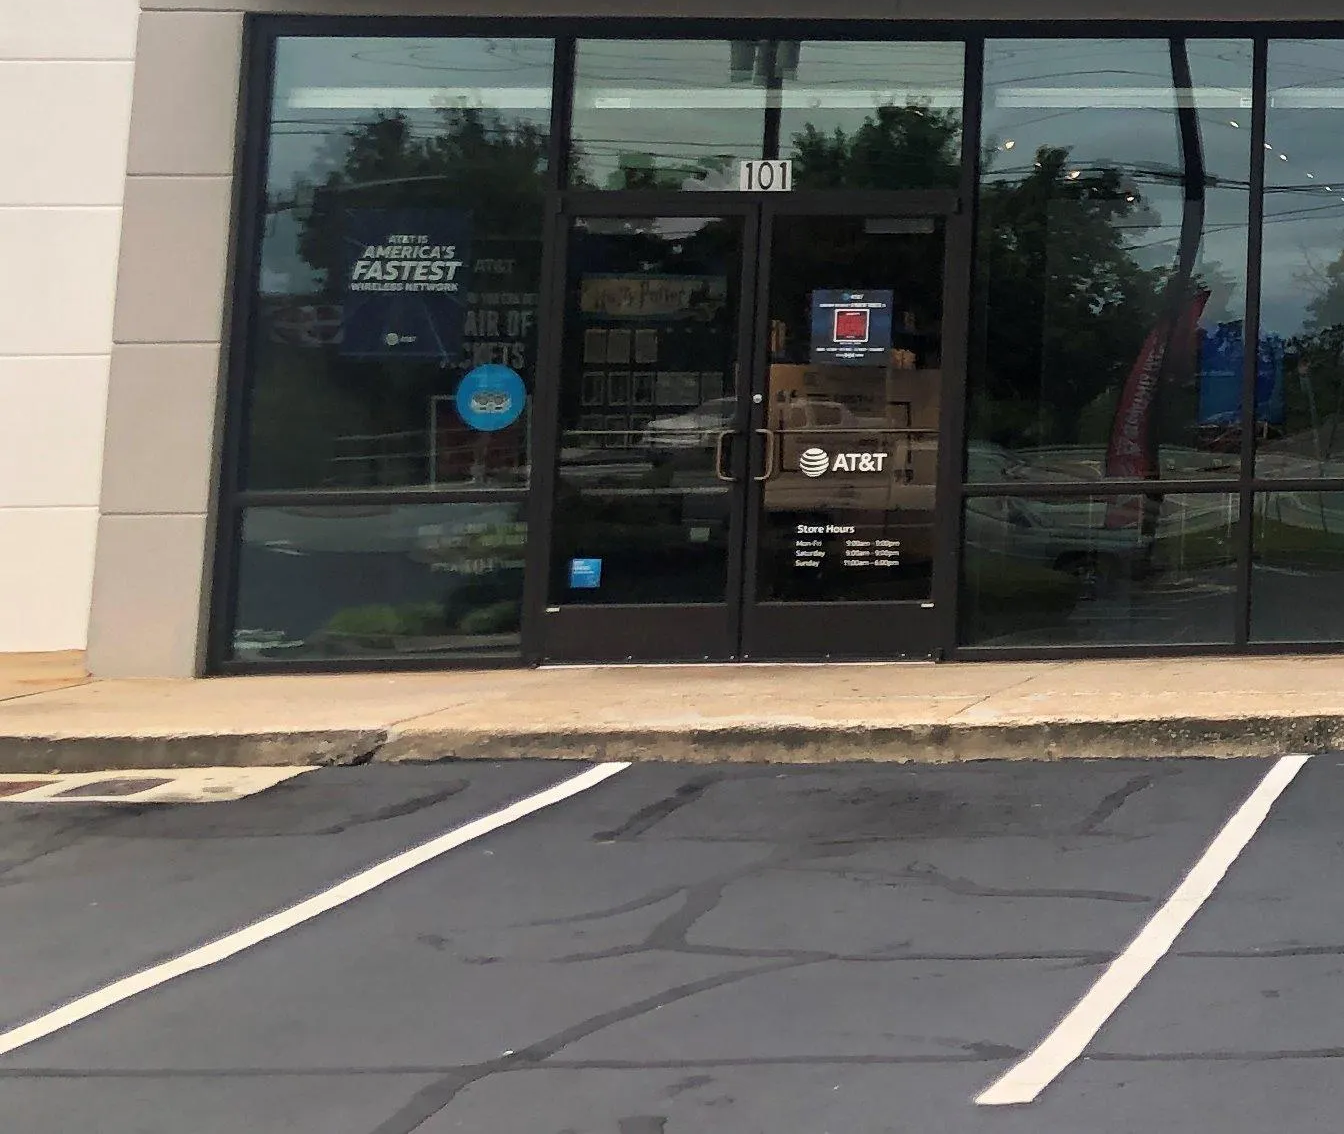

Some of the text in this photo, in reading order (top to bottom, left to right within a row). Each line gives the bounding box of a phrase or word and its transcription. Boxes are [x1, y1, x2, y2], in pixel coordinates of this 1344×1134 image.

[746, 161, 787, 190] 101
[362, 245, 456, 259] AMERICA'S
[351, 260, 463, 281] FASTEST
[350, 282, 459, 291] WIRELESS NETWORK
[832, 453, 888, 472] AT&T
[797, 524, 855, 534] Store Hours
[795, 550, 825, 558] Saturday
